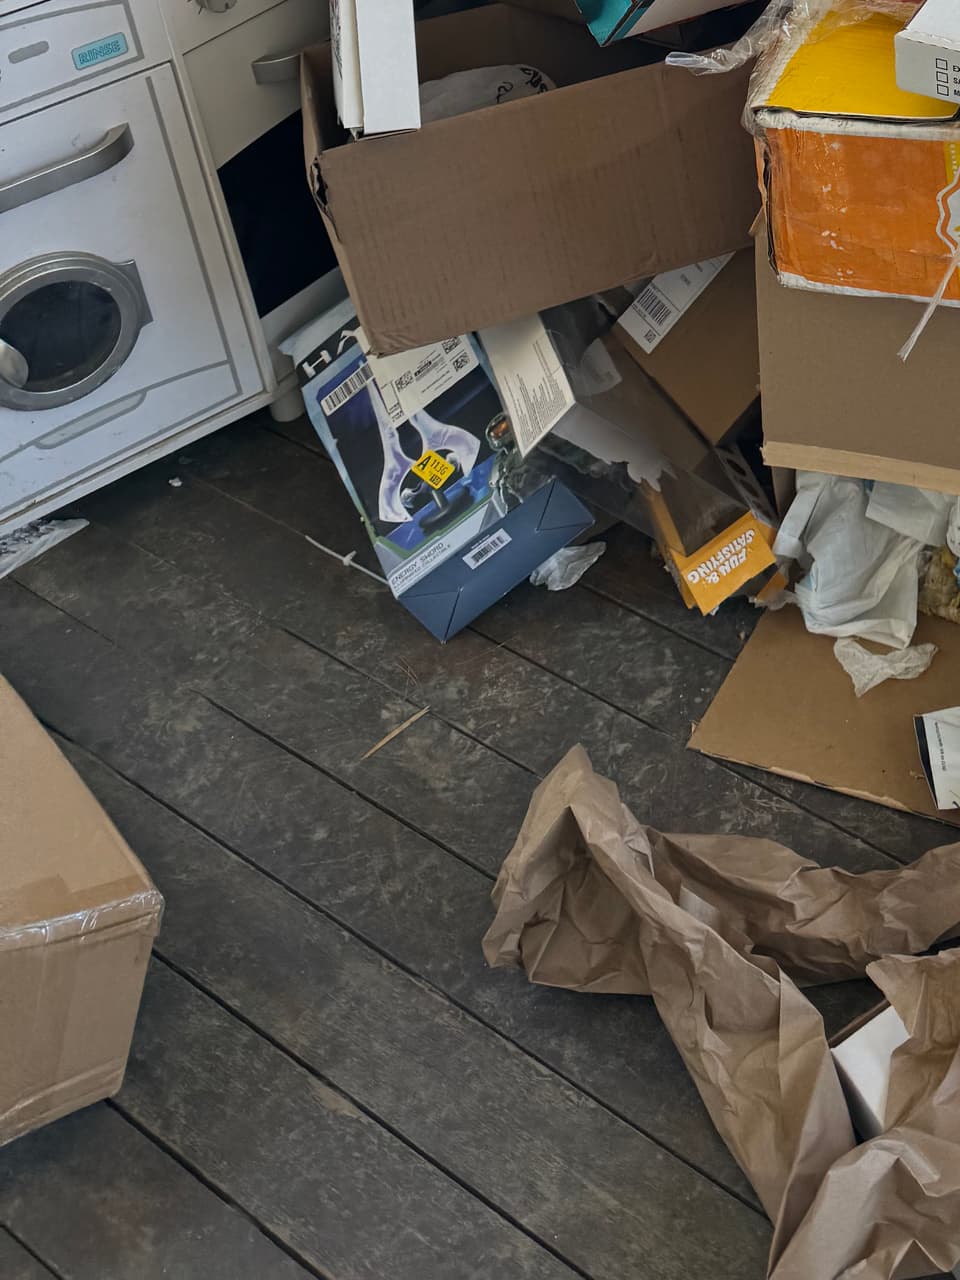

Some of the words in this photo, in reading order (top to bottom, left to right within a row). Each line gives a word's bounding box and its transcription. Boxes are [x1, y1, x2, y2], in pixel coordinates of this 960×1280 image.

[78, 40, 121, 65] RINSE
[416, 455, 432, 471] A
[686, 528, 756, 584] SATISFYING
[718, 548, 748, 577] FUN
[705, 570, 721, 584] &
